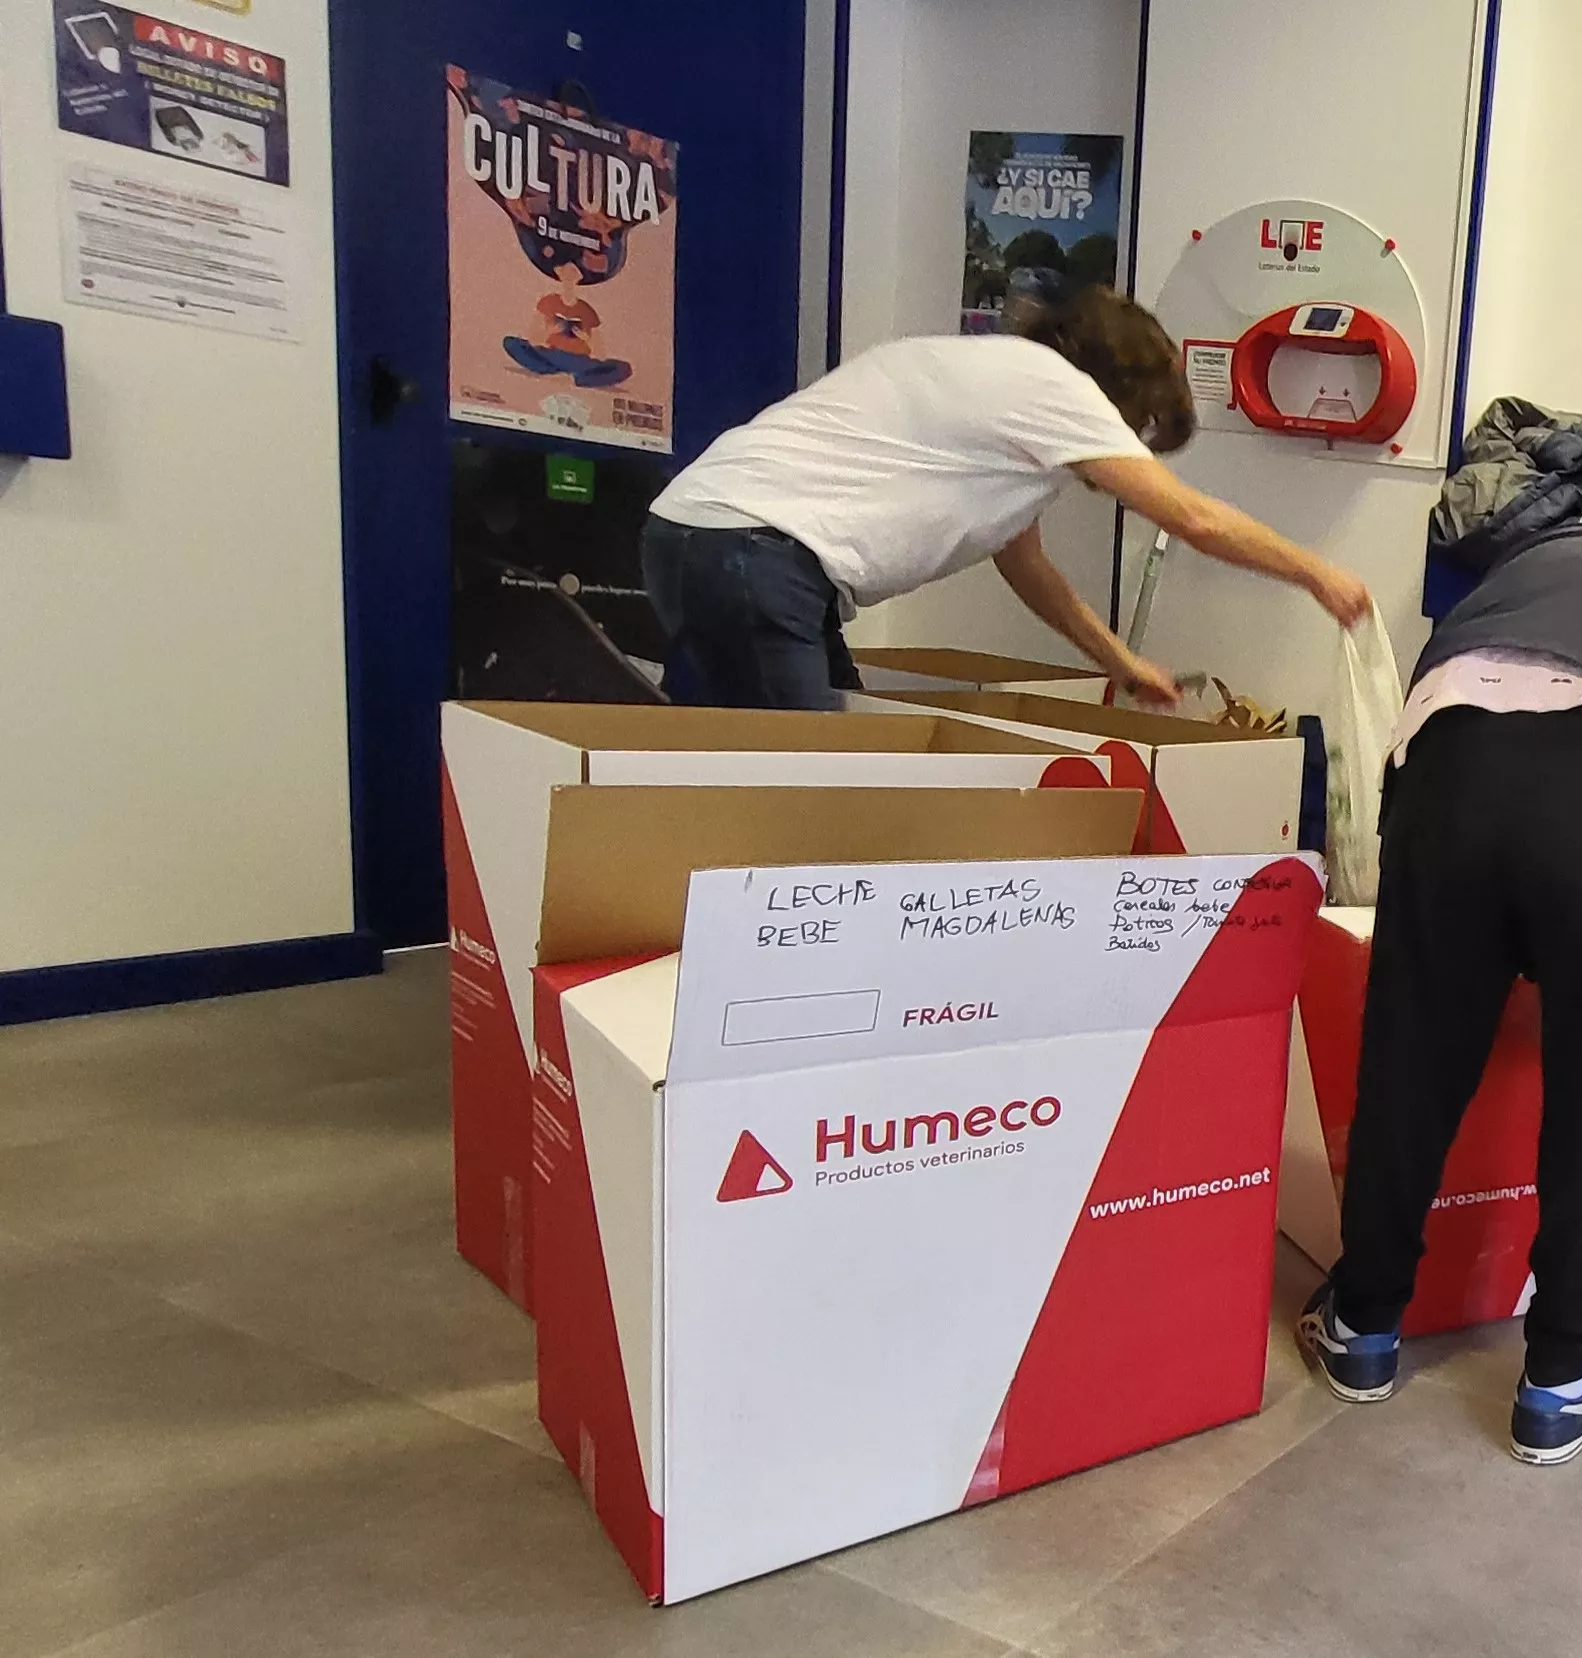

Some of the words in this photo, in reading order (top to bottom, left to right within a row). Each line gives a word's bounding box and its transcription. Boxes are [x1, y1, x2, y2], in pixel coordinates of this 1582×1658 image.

[149, 25, 268, 76] AVISO
[464, 112, 660, 225] CULTURA
[997, 167, 1022, 186] ¿Y
[1024, 168, 1045, 188] SI
[1047, 168, 1091, 189] CAE
[538, 215, 547, 237] 9
[767, 879, 877, 911] LECHE
[900, 878, 1043, 912] GALLETAS
[1116, 871, 1199, 898] BOTES
[757, 919, 843, 947] BEBE
[900, 901, 1077, 940] MAGDALENAS
[903, 1002, 999, 1028] FRÁGIL
[816, 1096, 1061, 1163] Humeco
[815, 1159, 915, 1187] Productos
[920, 1141, 1025, 1169] veterinarios
[1089, 1166, 1271, 1220] www.humeco.net
[1431, 1183, 1538, 1209] w.humeco.ne
